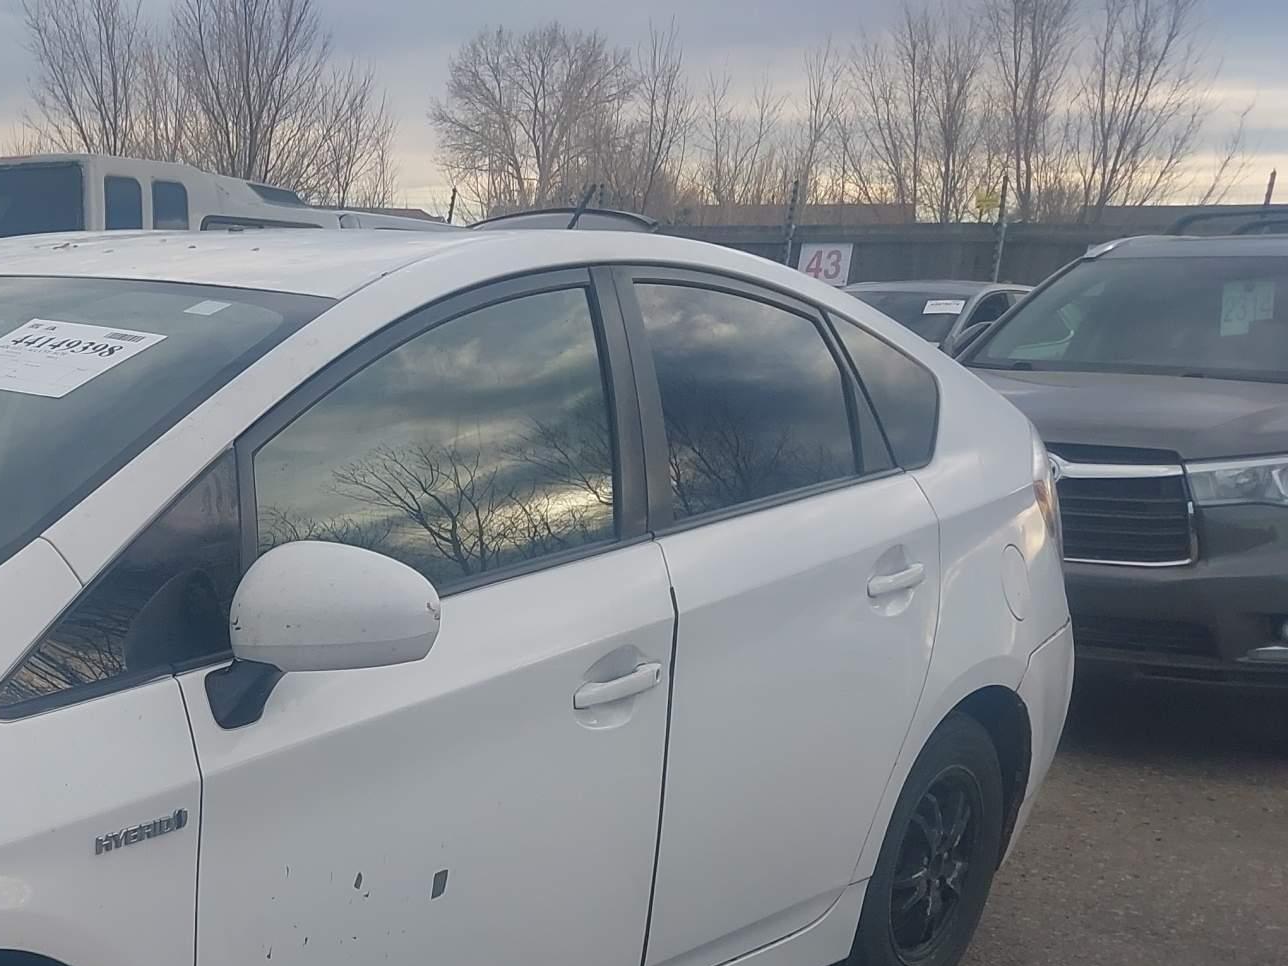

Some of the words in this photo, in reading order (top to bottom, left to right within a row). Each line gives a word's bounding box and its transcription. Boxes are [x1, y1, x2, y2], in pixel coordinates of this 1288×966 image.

[805, 249, 842, 279] 43
[11, 335, 124, 357] 44149398
[95, 815, 176, 855] HYBRID
